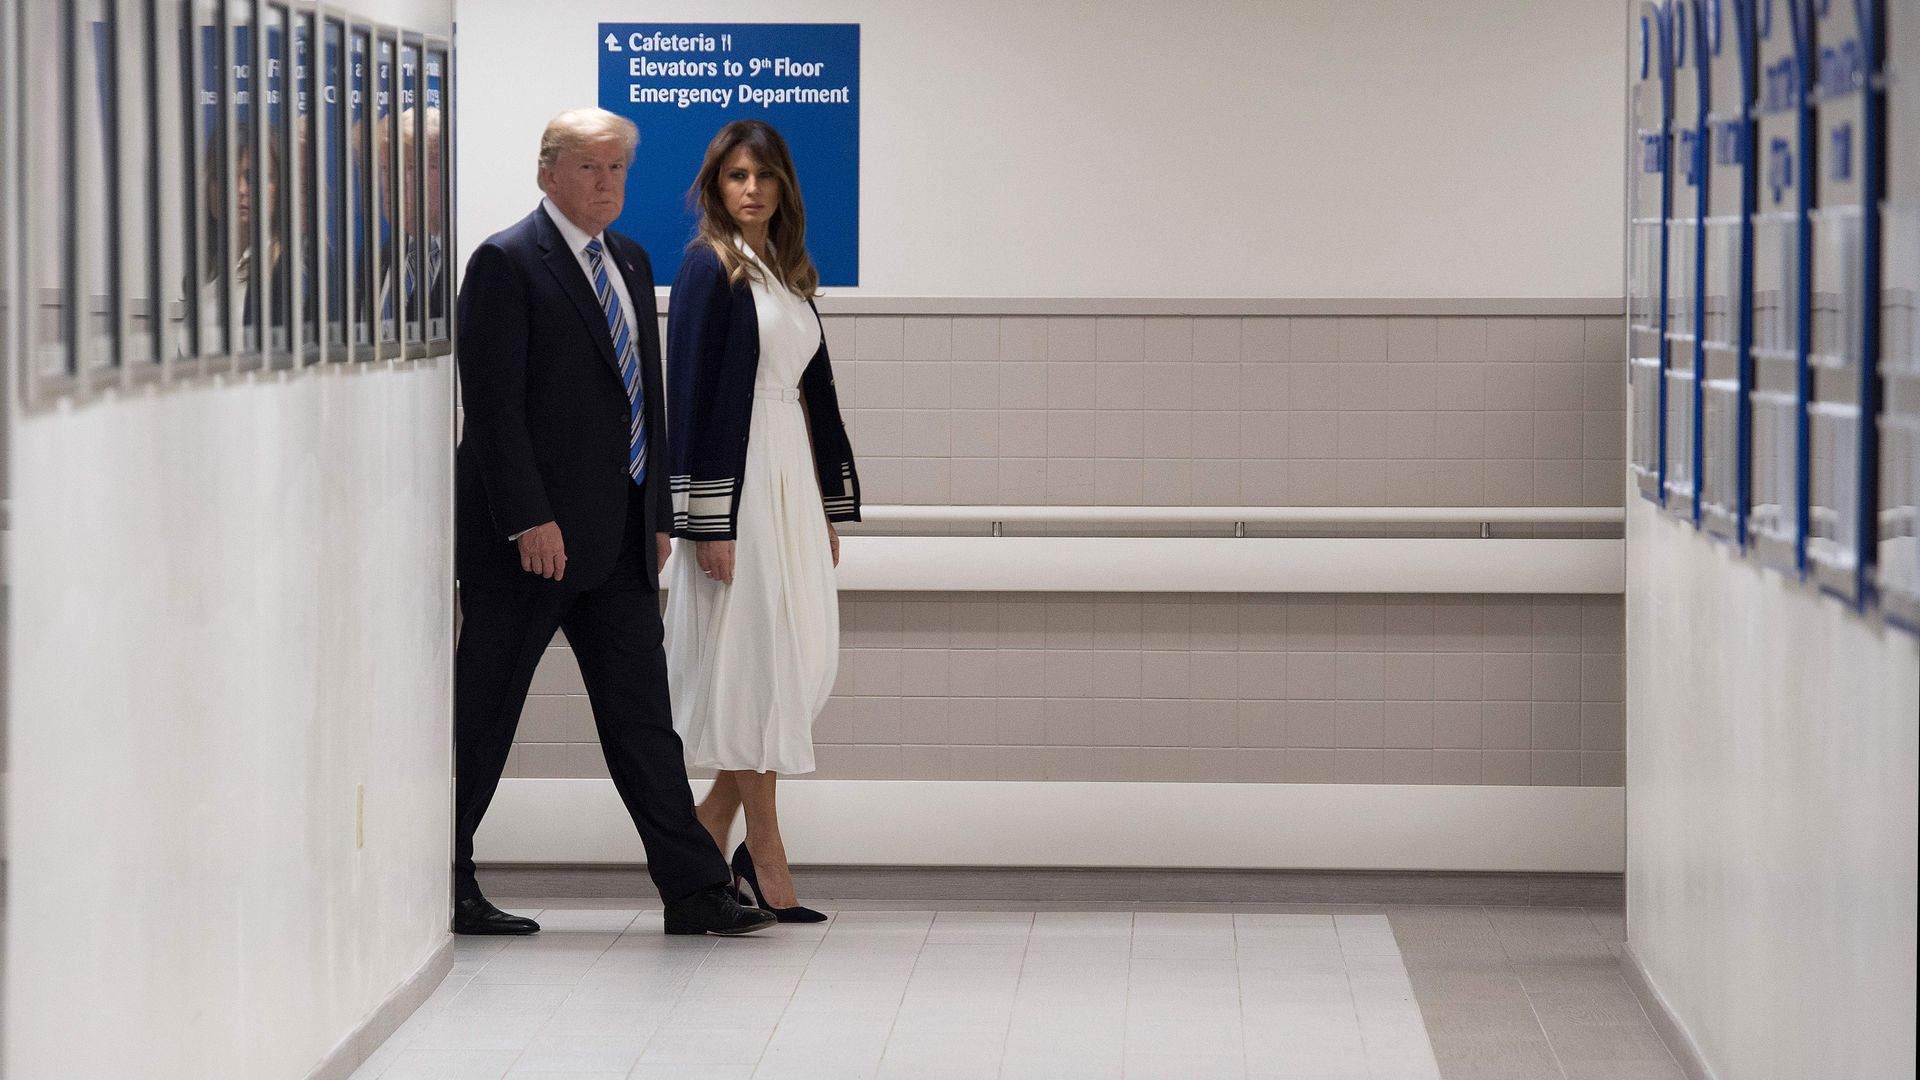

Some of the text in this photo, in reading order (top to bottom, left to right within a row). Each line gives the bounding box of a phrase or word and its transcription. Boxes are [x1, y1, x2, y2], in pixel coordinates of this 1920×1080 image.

[628, 32, 715, 52] Cafeteria
[629, 57, 825, 77] Elevators to 9th Floor
[629, 84, 850, 108] Emergency Department
